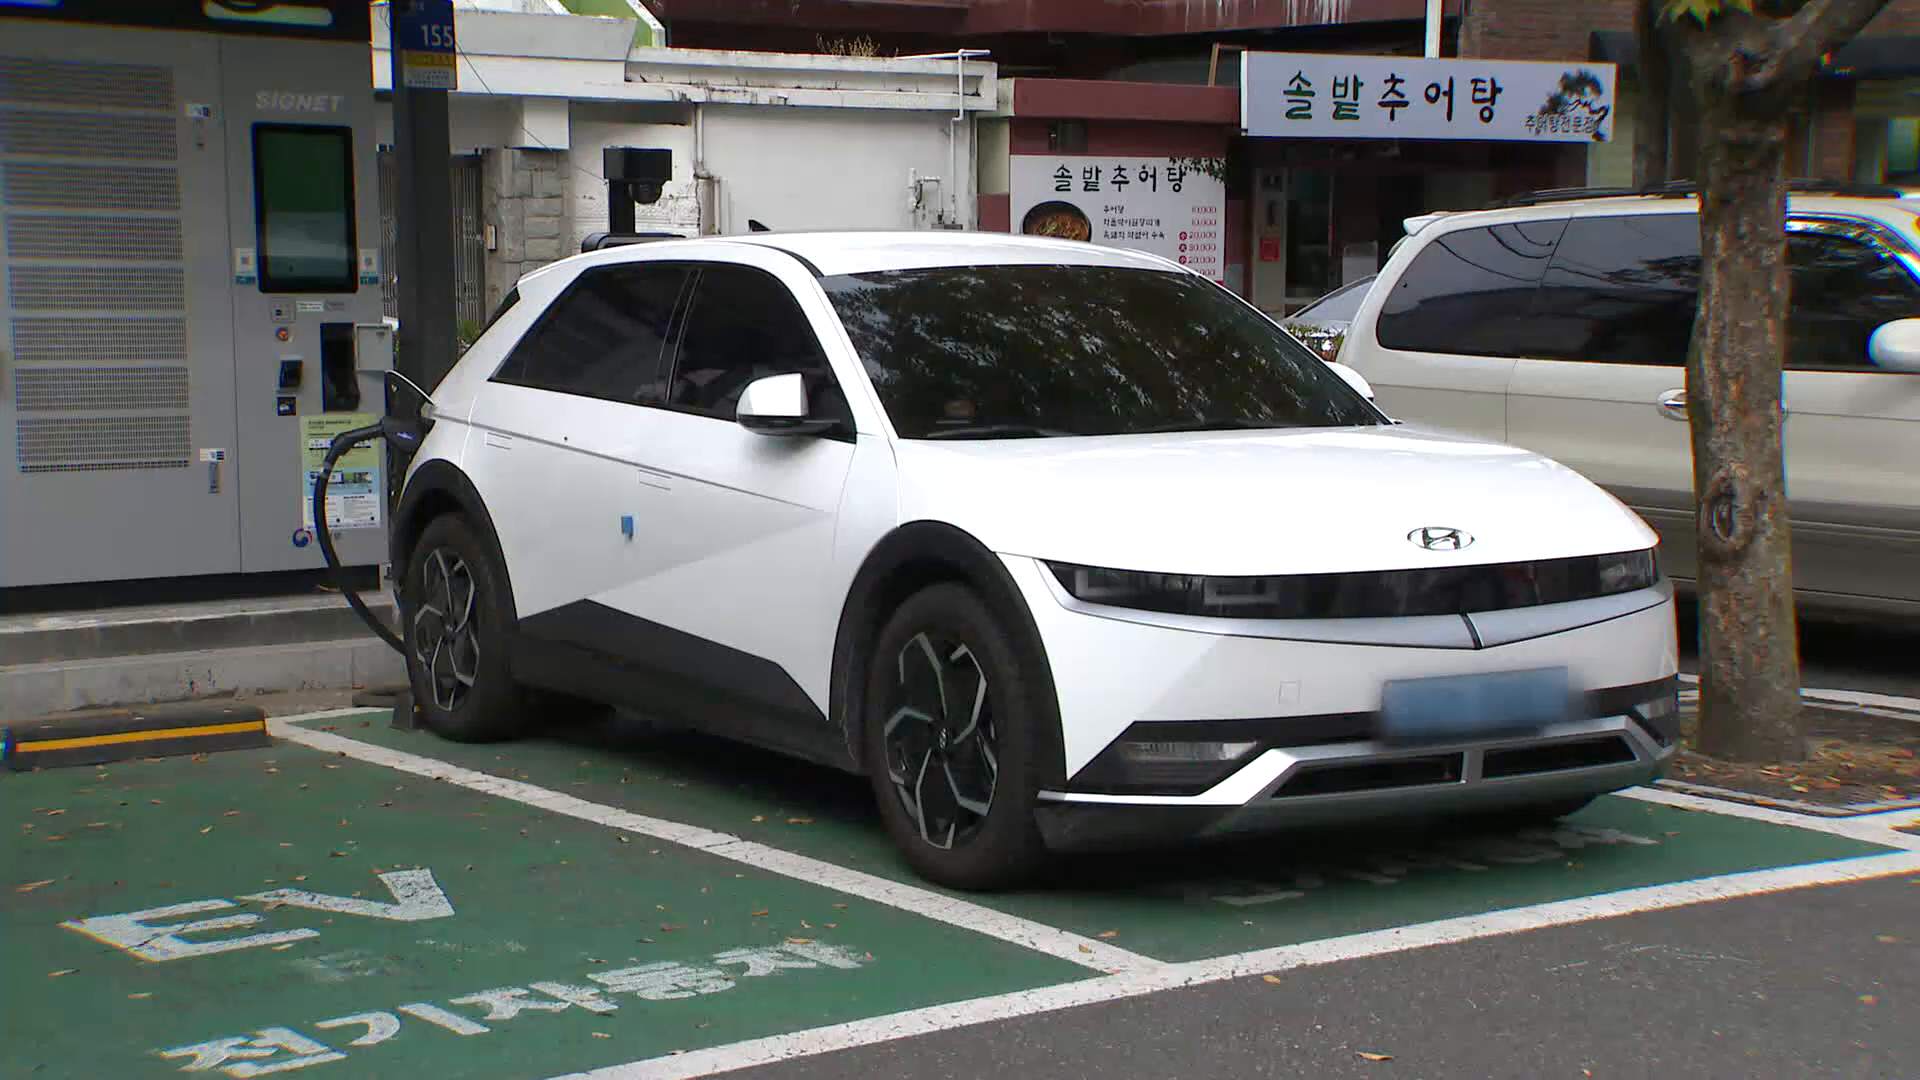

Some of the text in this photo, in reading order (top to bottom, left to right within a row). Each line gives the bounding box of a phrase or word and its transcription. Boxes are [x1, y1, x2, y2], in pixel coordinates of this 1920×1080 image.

[256, 90, 344, 113] SIGNET
[61, 868, 455, 962] EV
[160, 937, 870, 1078] 전기자동차
